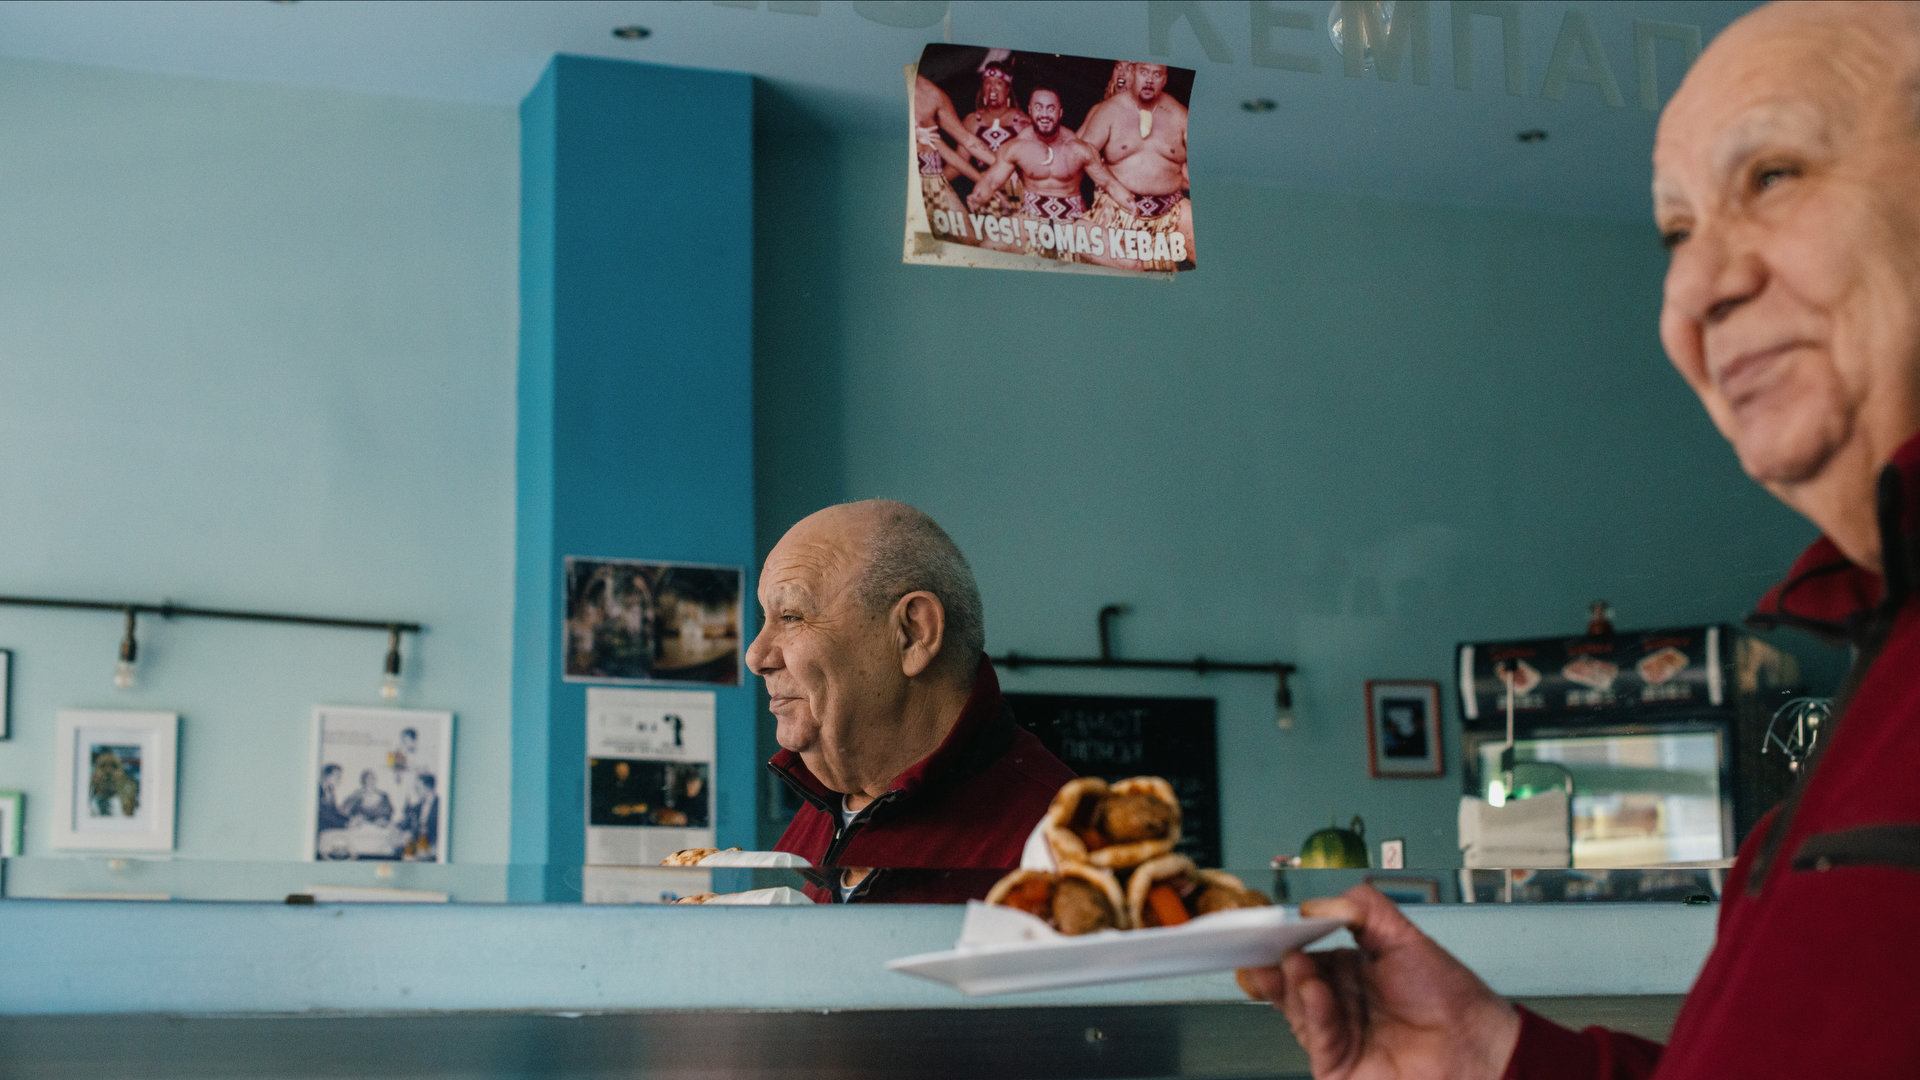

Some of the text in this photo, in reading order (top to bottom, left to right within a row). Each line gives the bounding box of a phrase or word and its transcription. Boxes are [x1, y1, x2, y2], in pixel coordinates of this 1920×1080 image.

[933, 209, 968, 237] OH
[1024, 220, 1104, 256] TOMAS
[1108, 228, 1187, 262] KEBAB
